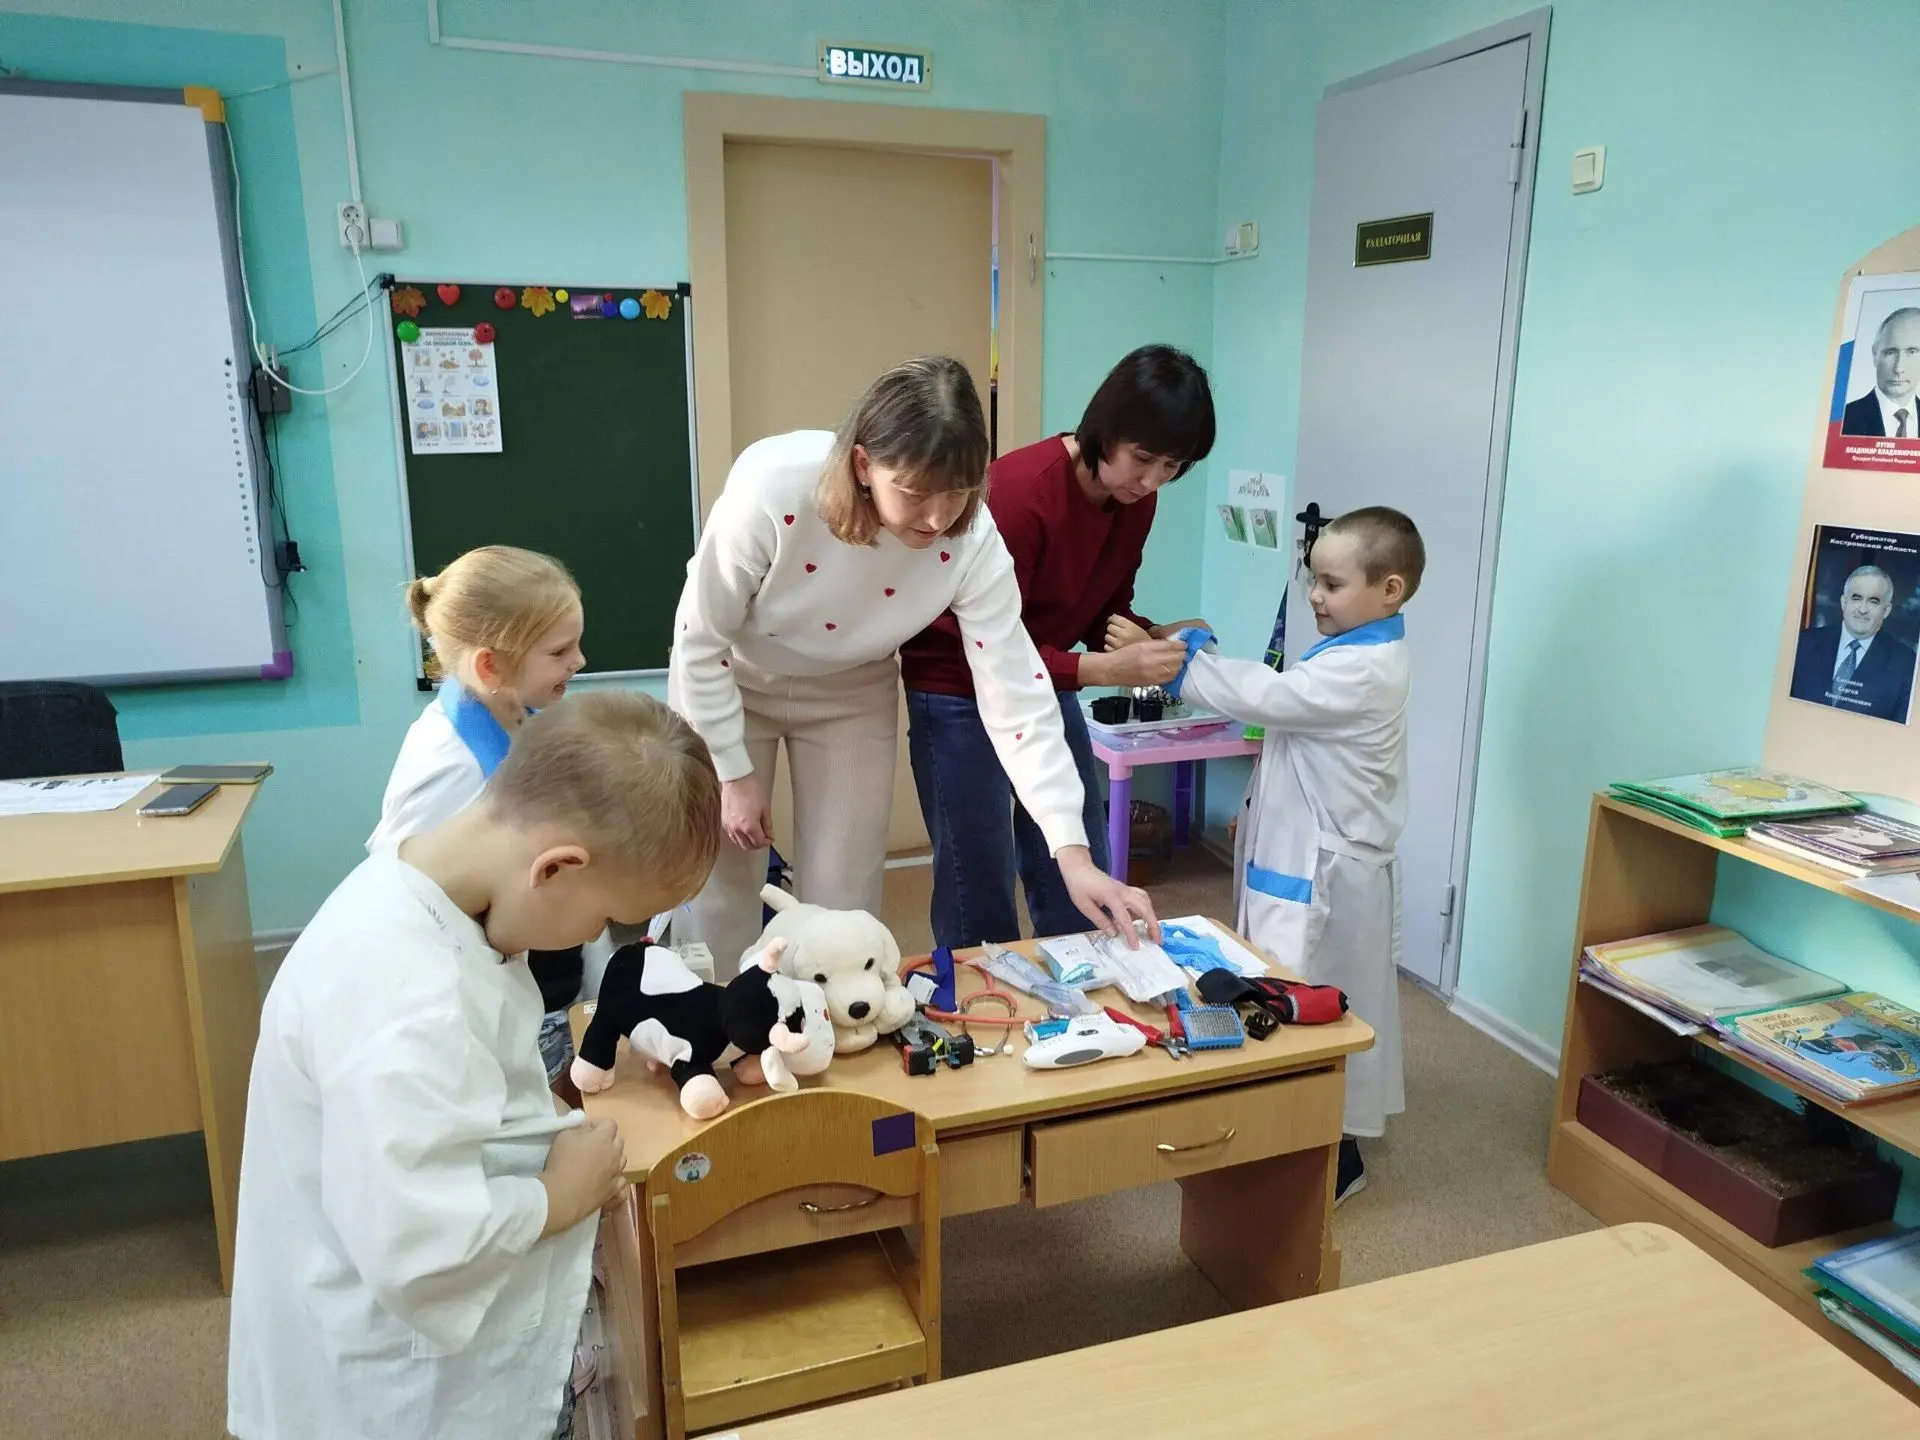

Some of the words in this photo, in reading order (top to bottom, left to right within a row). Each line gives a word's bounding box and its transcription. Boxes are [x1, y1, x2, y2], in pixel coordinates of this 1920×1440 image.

[830, 48, 920, 84] ВЫХОД
[1829, 538, 1881, 550] Костромской
[1883, 545, 1918, 553] области
[1850, 533, 1898, 544] Губернатор
